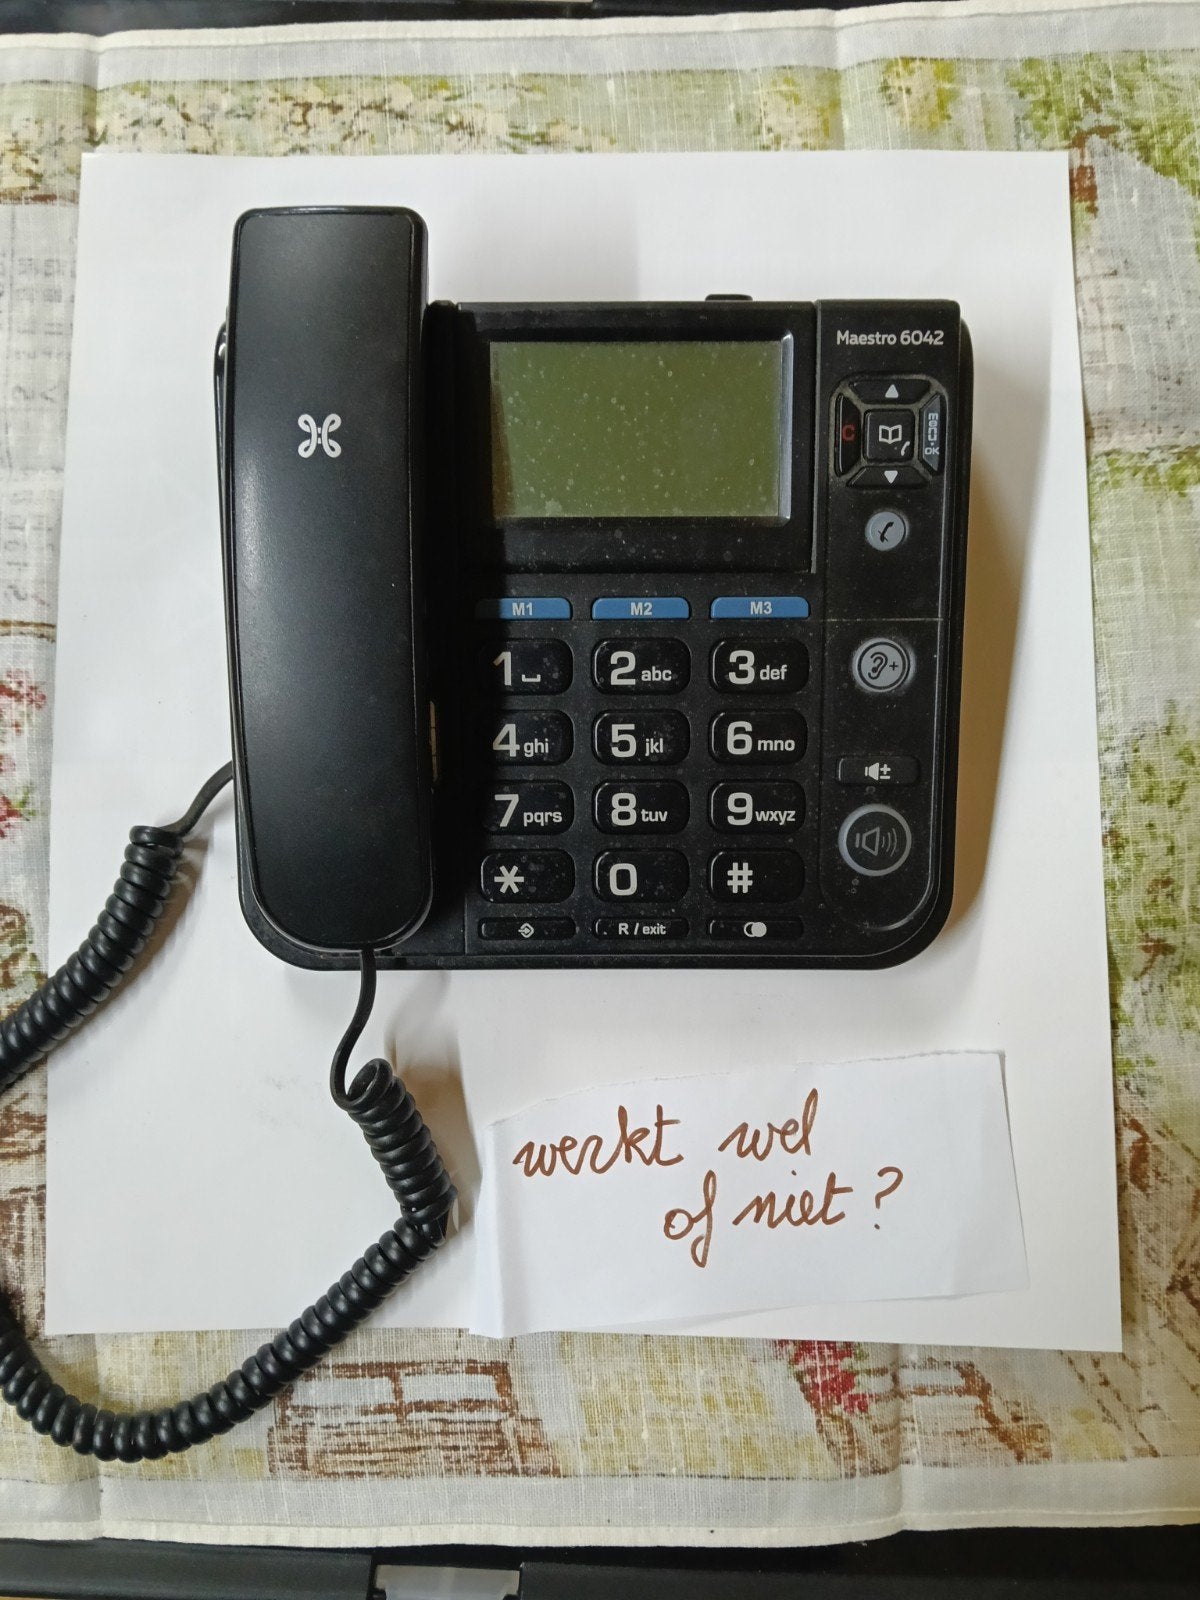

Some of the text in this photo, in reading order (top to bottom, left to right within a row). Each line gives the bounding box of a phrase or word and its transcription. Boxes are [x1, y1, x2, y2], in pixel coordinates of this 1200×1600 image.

[836, 329, 945, 346] Maestro 6042
[842, 424, 856, 441] C
[928, 412, 939, 442] menu
[924, 446, 940, 455] OK
[511, 602, 534, 616] M1
[630, 602, 653, 616] M2
[750, 601, 773, 615] M3
[492, 651, 513, 687] 1
[610, 651, 672, 686] 2 abc
[728, 649, 788, 685] 3 def
[492, 723, 550, 758] 4 ghi
[611, 723, 664, 758] 5 jkl
[726, 720, 796, 755] 6 mno
[494, 793, 563, 828] 7 pqrs
[611, 792, 669, 827] 8 tuv
[727, 792, 796, 826] 9 wxyz
[609, 863, 638, 896] 0
[727, 862, 754, 894] #
[618, 922, 630, 936] R
[642, 922, 667, 936] exit
[513, 1088, 819, 1178] werkt wel
[664, 1169, 717, 1269] of
[732, 1169, 854, 1230] niet
